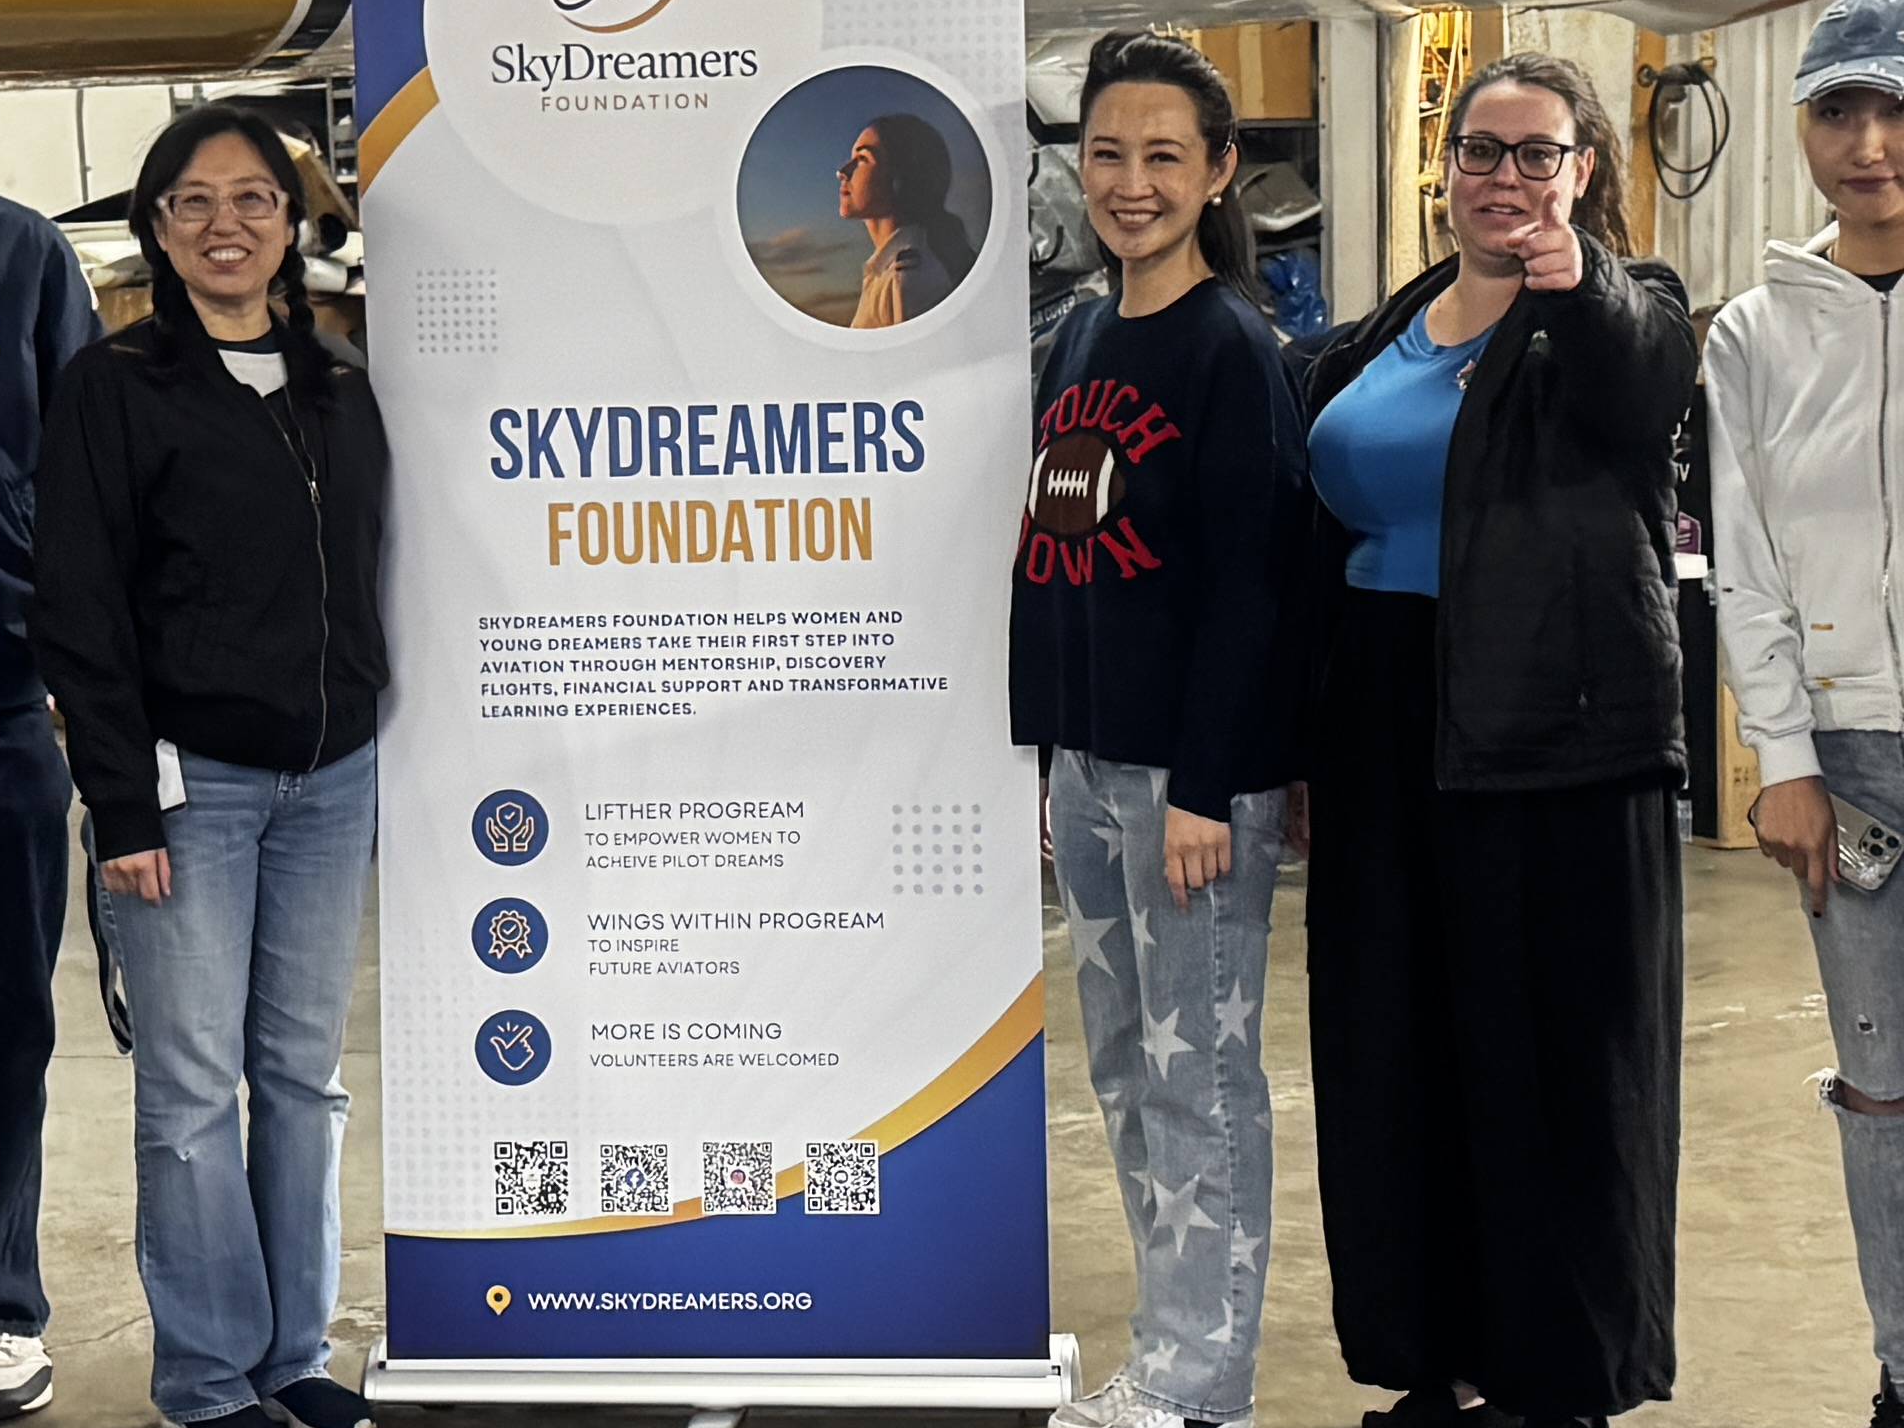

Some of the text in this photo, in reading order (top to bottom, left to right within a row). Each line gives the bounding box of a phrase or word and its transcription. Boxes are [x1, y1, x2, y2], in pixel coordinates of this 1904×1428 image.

[492, 43, 757, 92] SkyDreamers
[542, 93, 707, 112] FOUNDATION
[1040, 380, 1182, 464] TOUCH
[490, 400, 924, 479] SKYDREAMERS
[548, 497, 872, 566] FOUNDATION
[479, 611, 902, 629] SKYDREAMERS FOUNDATION HELPS WOMEN AND
[480, 633, 894, 651] YOUNG DREAMERS TAKE THEIR FIRST STEP INTO
[480, 656, 886, 673] AVIATION THROUGH MENTORSHIP, DISCOVERY
[482, 677, 947, 696] FLIGHTS, FINANCIAL SUPPORT AND TRANSFORMATIVE
[482, 703, 696, 718] LEARNING EXPERIENCES.
[586, 802, 803, 820] LIFTHER PROGREAM
[585, 831, 800, 846] TO EMPOWER WOMEN TO
[586, 854, 783, 868] ACHEIVE PILOT DREAMS
[588, 913, 884, 930] WINGS WITHIN PROGREAM
[588, 939, 679, 952] TO INSPIRE
[590, 961, 739, 975] FUTURE AVIATORS
[592, 1023, 781, 1040] MORE IS COMING
[590, 1053, 839, 1067] VOLUNTEERS ARE WELCOMED
[528, 1293, 811, 1309] WWW.SKYDREAMERS.ORG
